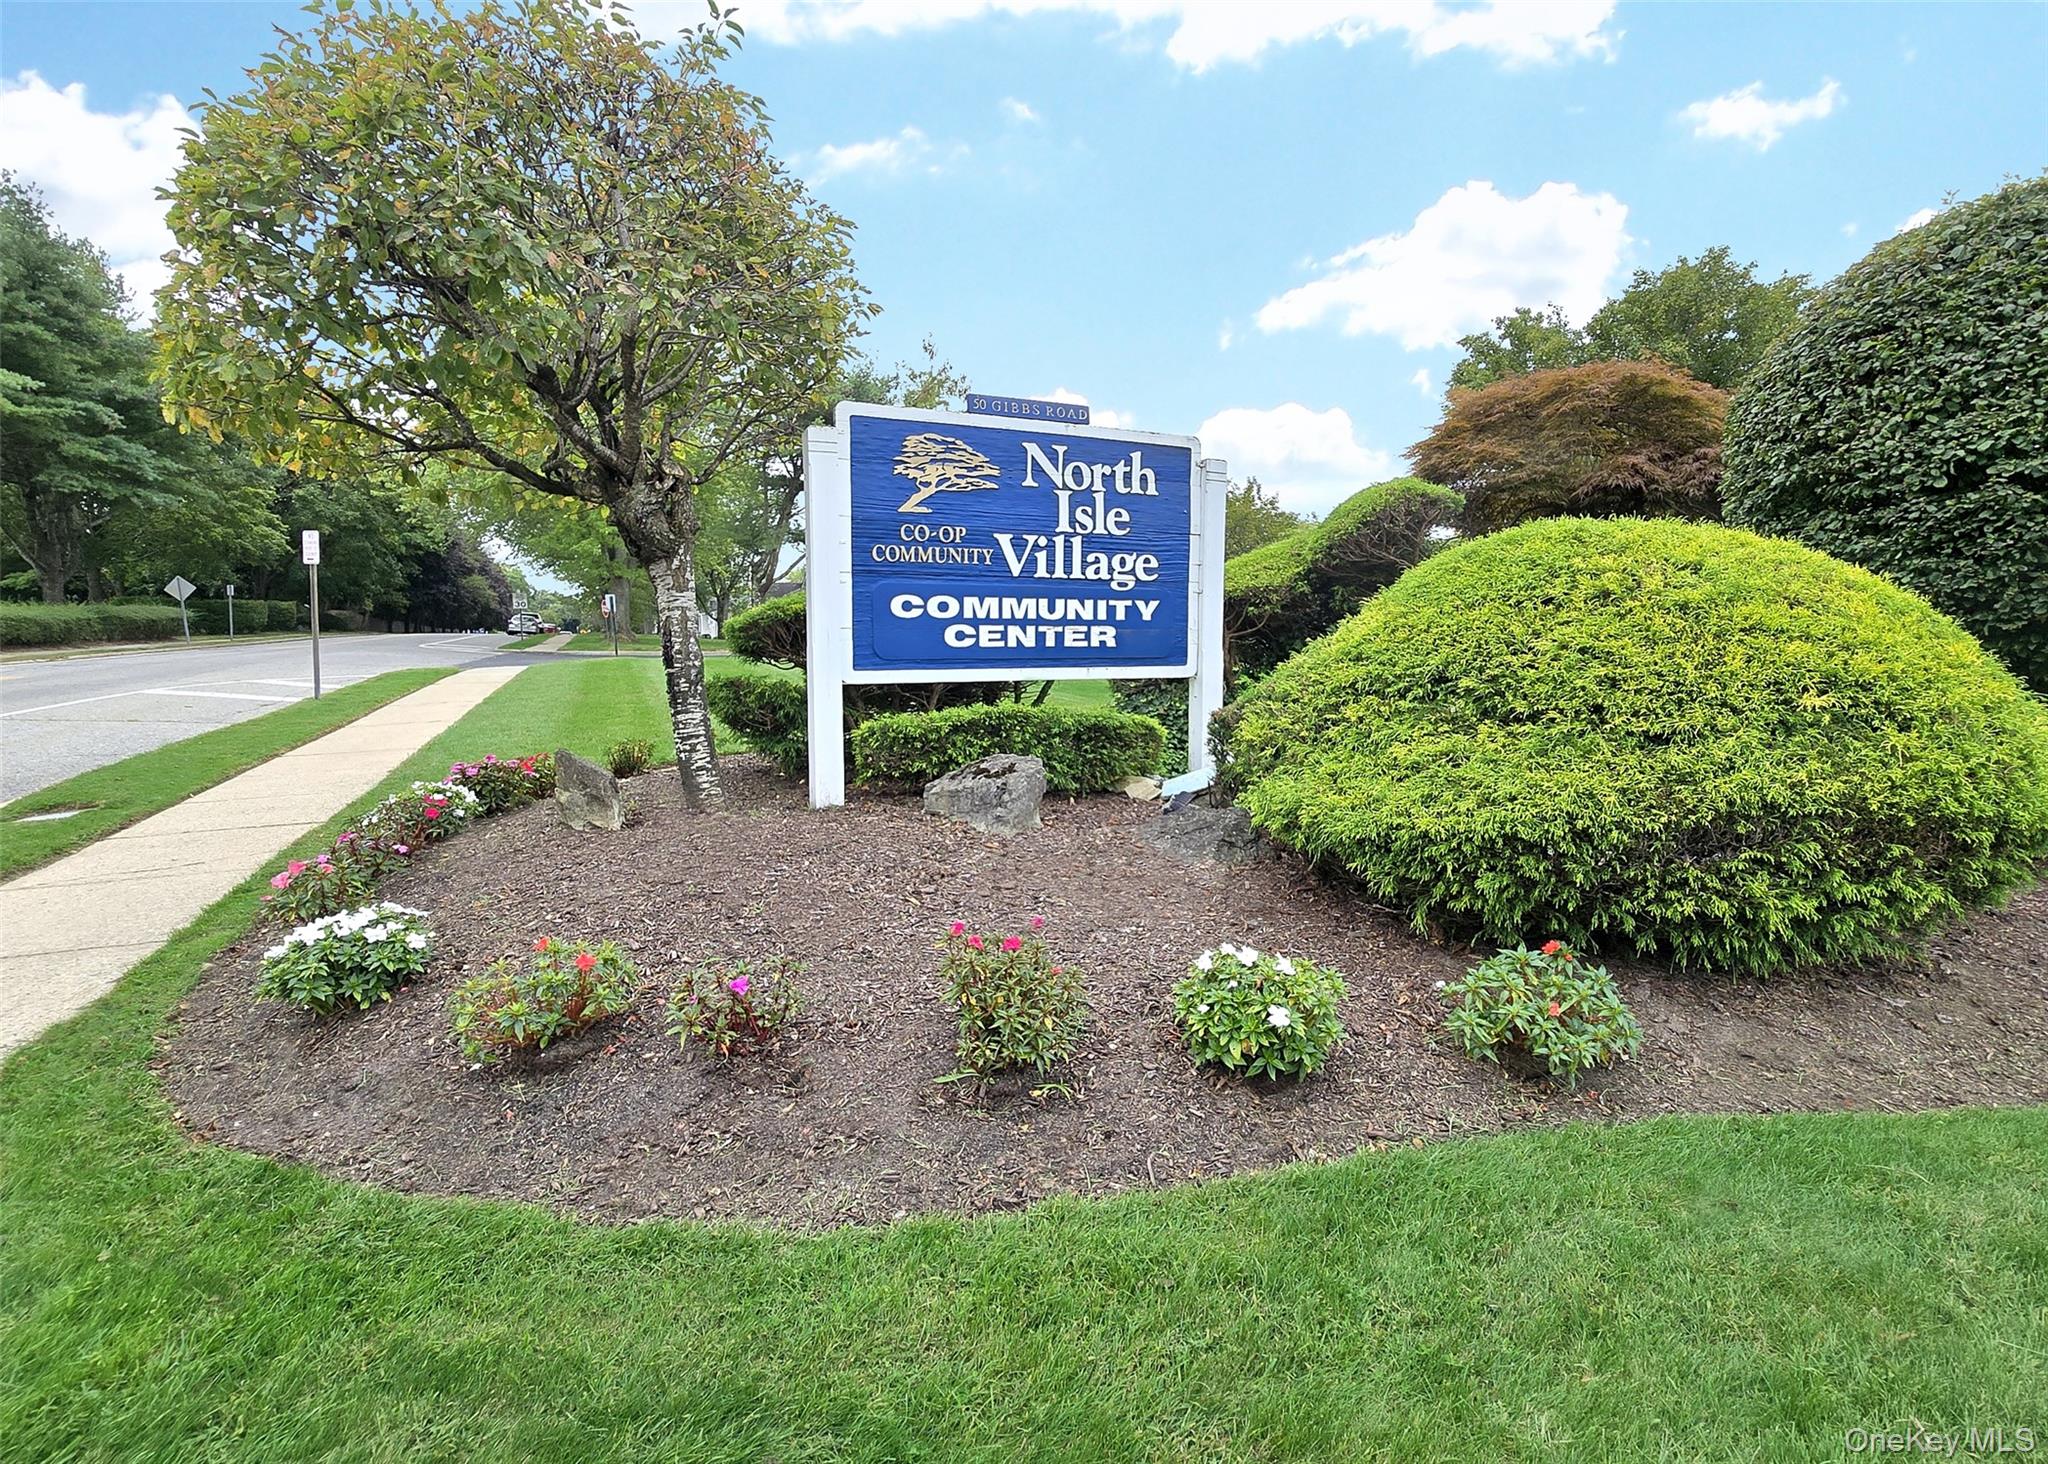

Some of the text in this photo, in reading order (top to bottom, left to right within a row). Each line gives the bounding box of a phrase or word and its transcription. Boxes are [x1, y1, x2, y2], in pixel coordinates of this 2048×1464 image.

[973, 399, 1088, 420] 50 GIBBS ROAD
[1021, 442, 1159, 496] North
[1053, 489, 1131, 536] Isle
[900, 523, 967, 543] CO-OP
[871, 544, 994, 565] COMMUNITY
[993, 533, 1159, 591] Village
[889, 594, 1161, 621] COMMUNITY
[943, 623, 1117, 648] CENTER
